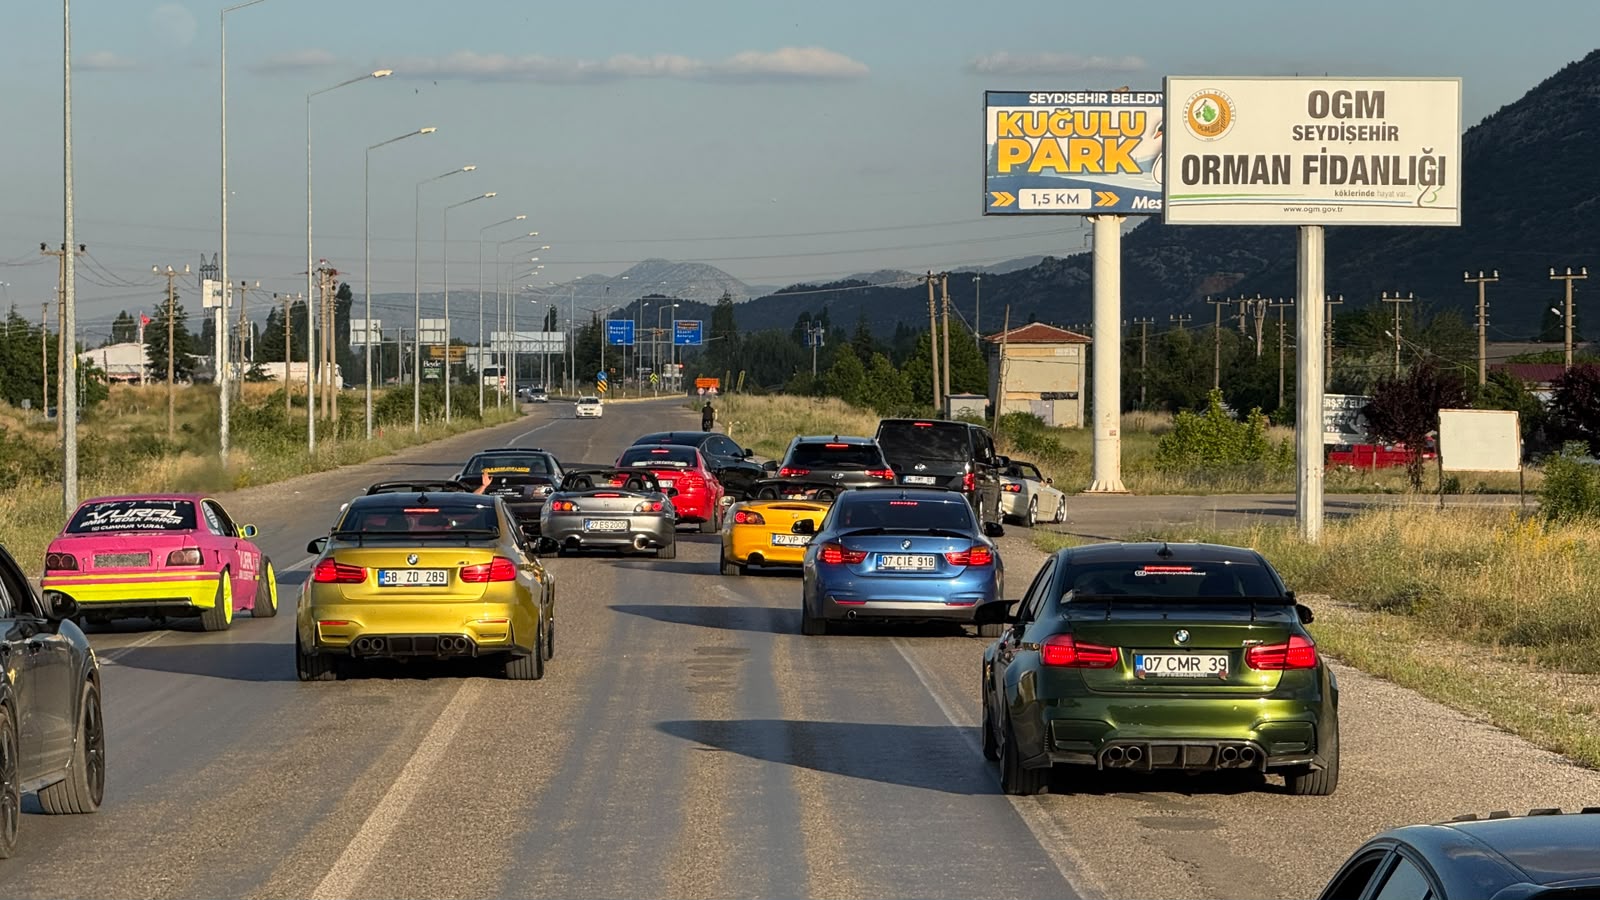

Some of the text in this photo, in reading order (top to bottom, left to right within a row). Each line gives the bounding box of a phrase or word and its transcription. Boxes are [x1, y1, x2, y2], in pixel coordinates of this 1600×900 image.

[1307, 90, 1385, 119] OGM
[997, 108, 1146, 138] KUĞULU
[1292, 121, 1399, 144] SEYDİŞEHİR
[997, 138, 1143, 174] PARK
[1181, 147, 1446, 187] ORMAN FİDANLIĞI
[1031, 193, 1080, 206] 1,5 KM
[1283, 206, 1343, 214] www.ogm.gov.tr
[86, 508, 184, 520] VURAL
[590, 520, 599, 529] 27
[776, 535, 786, 543] 27
[882, 556, 934, 566] 07 CIE 918
[385, 571, 445, 583] 58 ZD 289
[1144, 657, 1227, 671] 07 CMR 39
